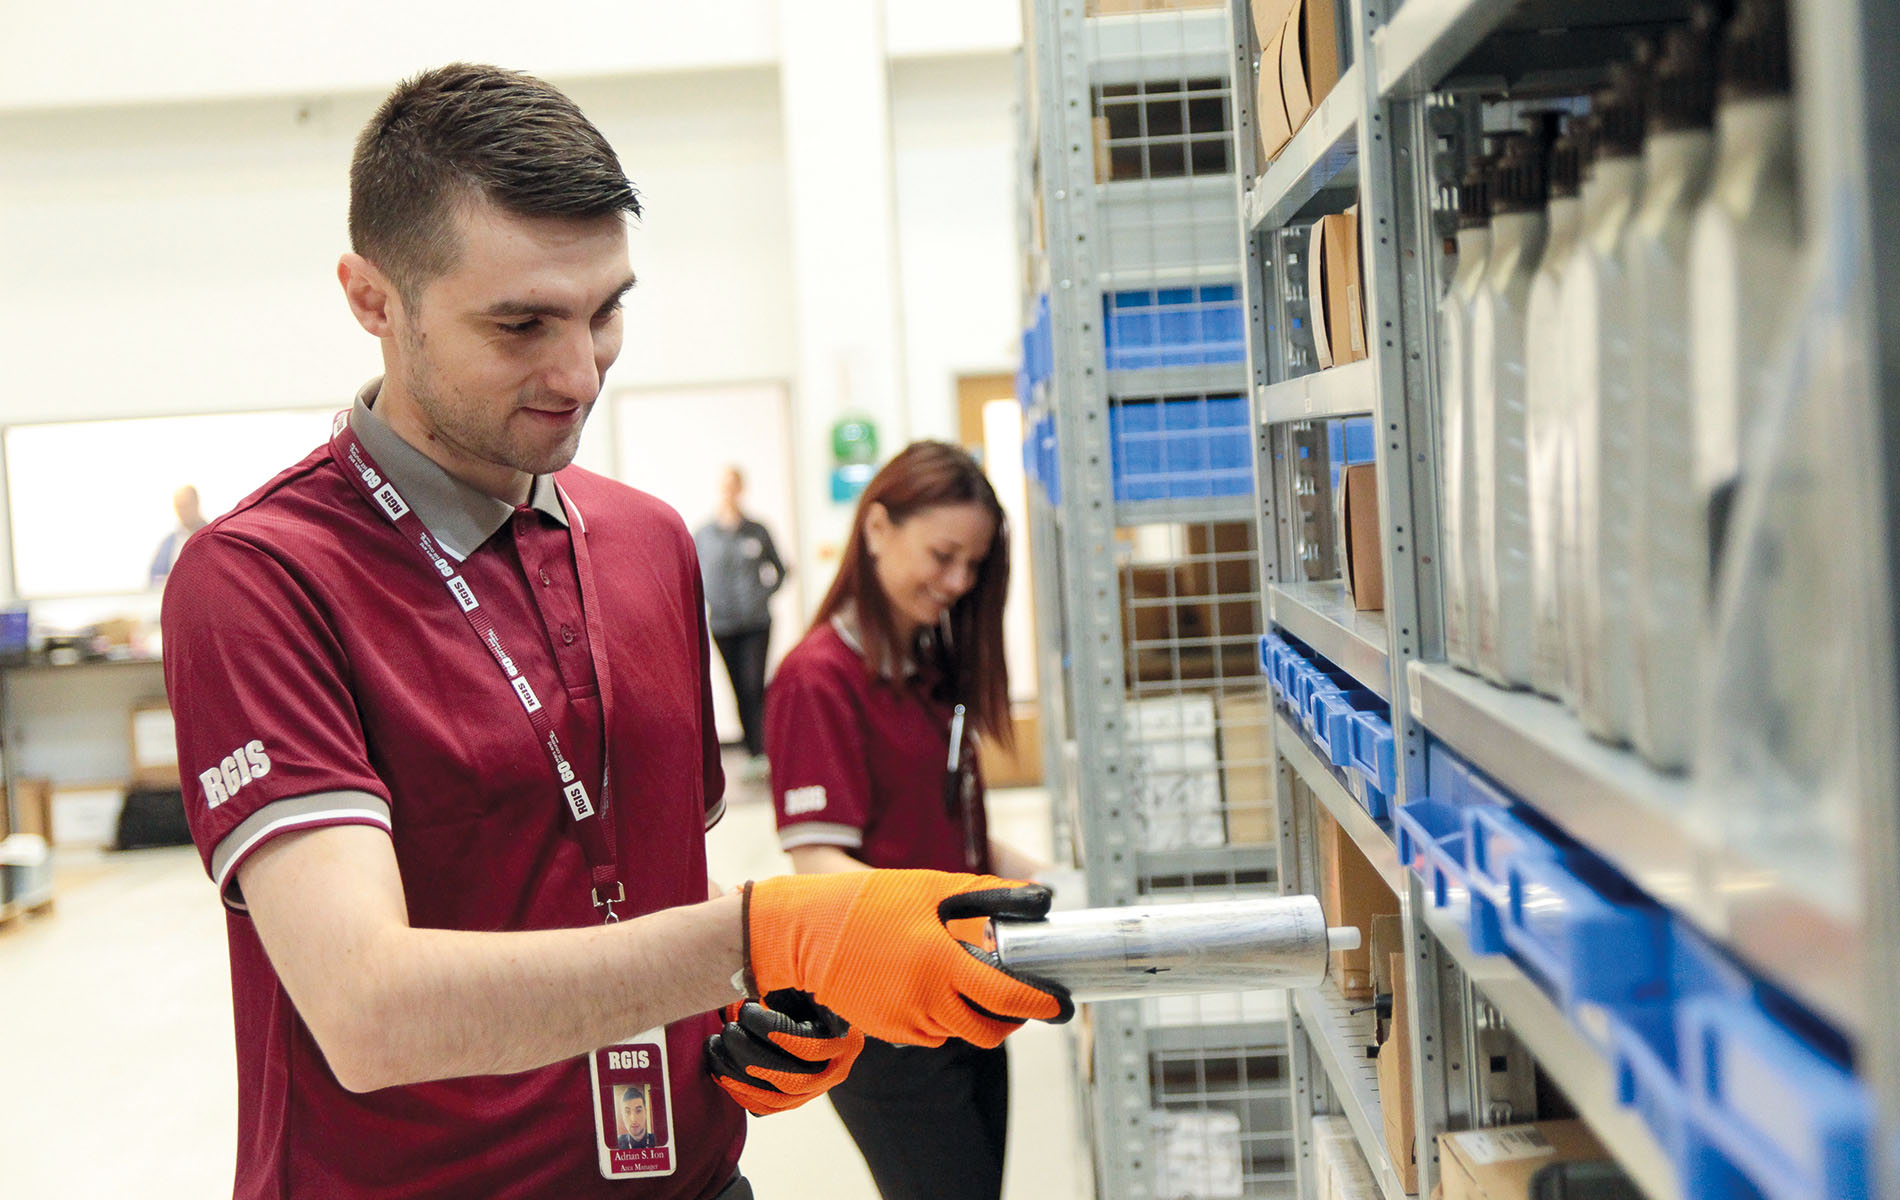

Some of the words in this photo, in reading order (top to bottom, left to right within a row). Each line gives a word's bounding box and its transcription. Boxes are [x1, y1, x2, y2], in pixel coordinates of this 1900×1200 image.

[361, 467, 381, 488] 60
[381, 490, 402, 514] RGIS
[434, 558, 454, 577] 60
[454, 581, 473, 606] RGIS
[518, 683, 536, 707] RGIS
[199, 739, 271, 810] RGIS
[556, 760, 575, 783] 60
[570, 788, 588, 815] RGIS
[608, 1050, 650, 1070] RGIS
[614, 1151, 640, 1161] Adrian
[641, 1150, 649, 1160] S.
[650, 1149, 664, 1159] Ion
[634, 1162, 659, 1172] Manager
